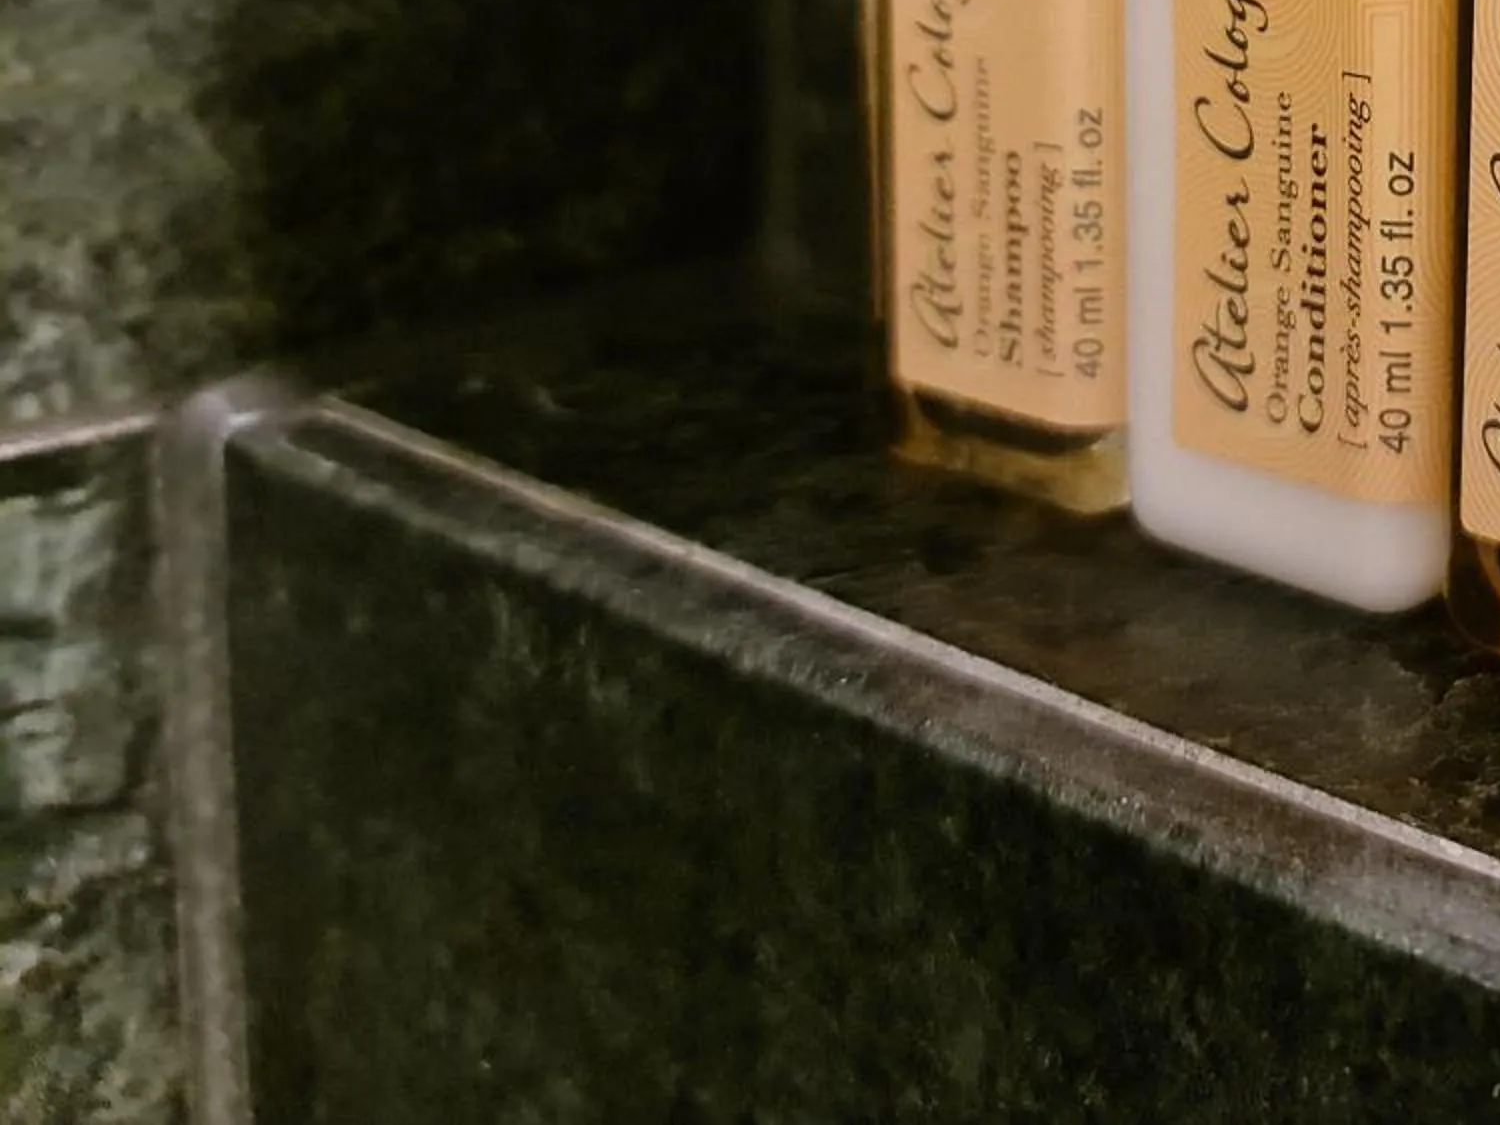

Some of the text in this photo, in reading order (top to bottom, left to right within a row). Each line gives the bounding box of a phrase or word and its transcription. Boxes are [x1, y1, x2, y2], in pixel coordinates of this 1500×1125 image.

[910, 141, 963, 349] Atelier
[974, 233, 996, 358] Orange
[1000, 150, 1029, 368] Shampoo
[1072, 107, 1104, 379] 40 ml 1.35 fl. oz
[1192, 176, 1256, 413] Atelier
[1266, 91, 1298, 424] Orange Sanguine
[1298, 123, 1328, 433] Conditioner
[1378, 151, 1415, 455] 40 ml 1.35 fl. oz
